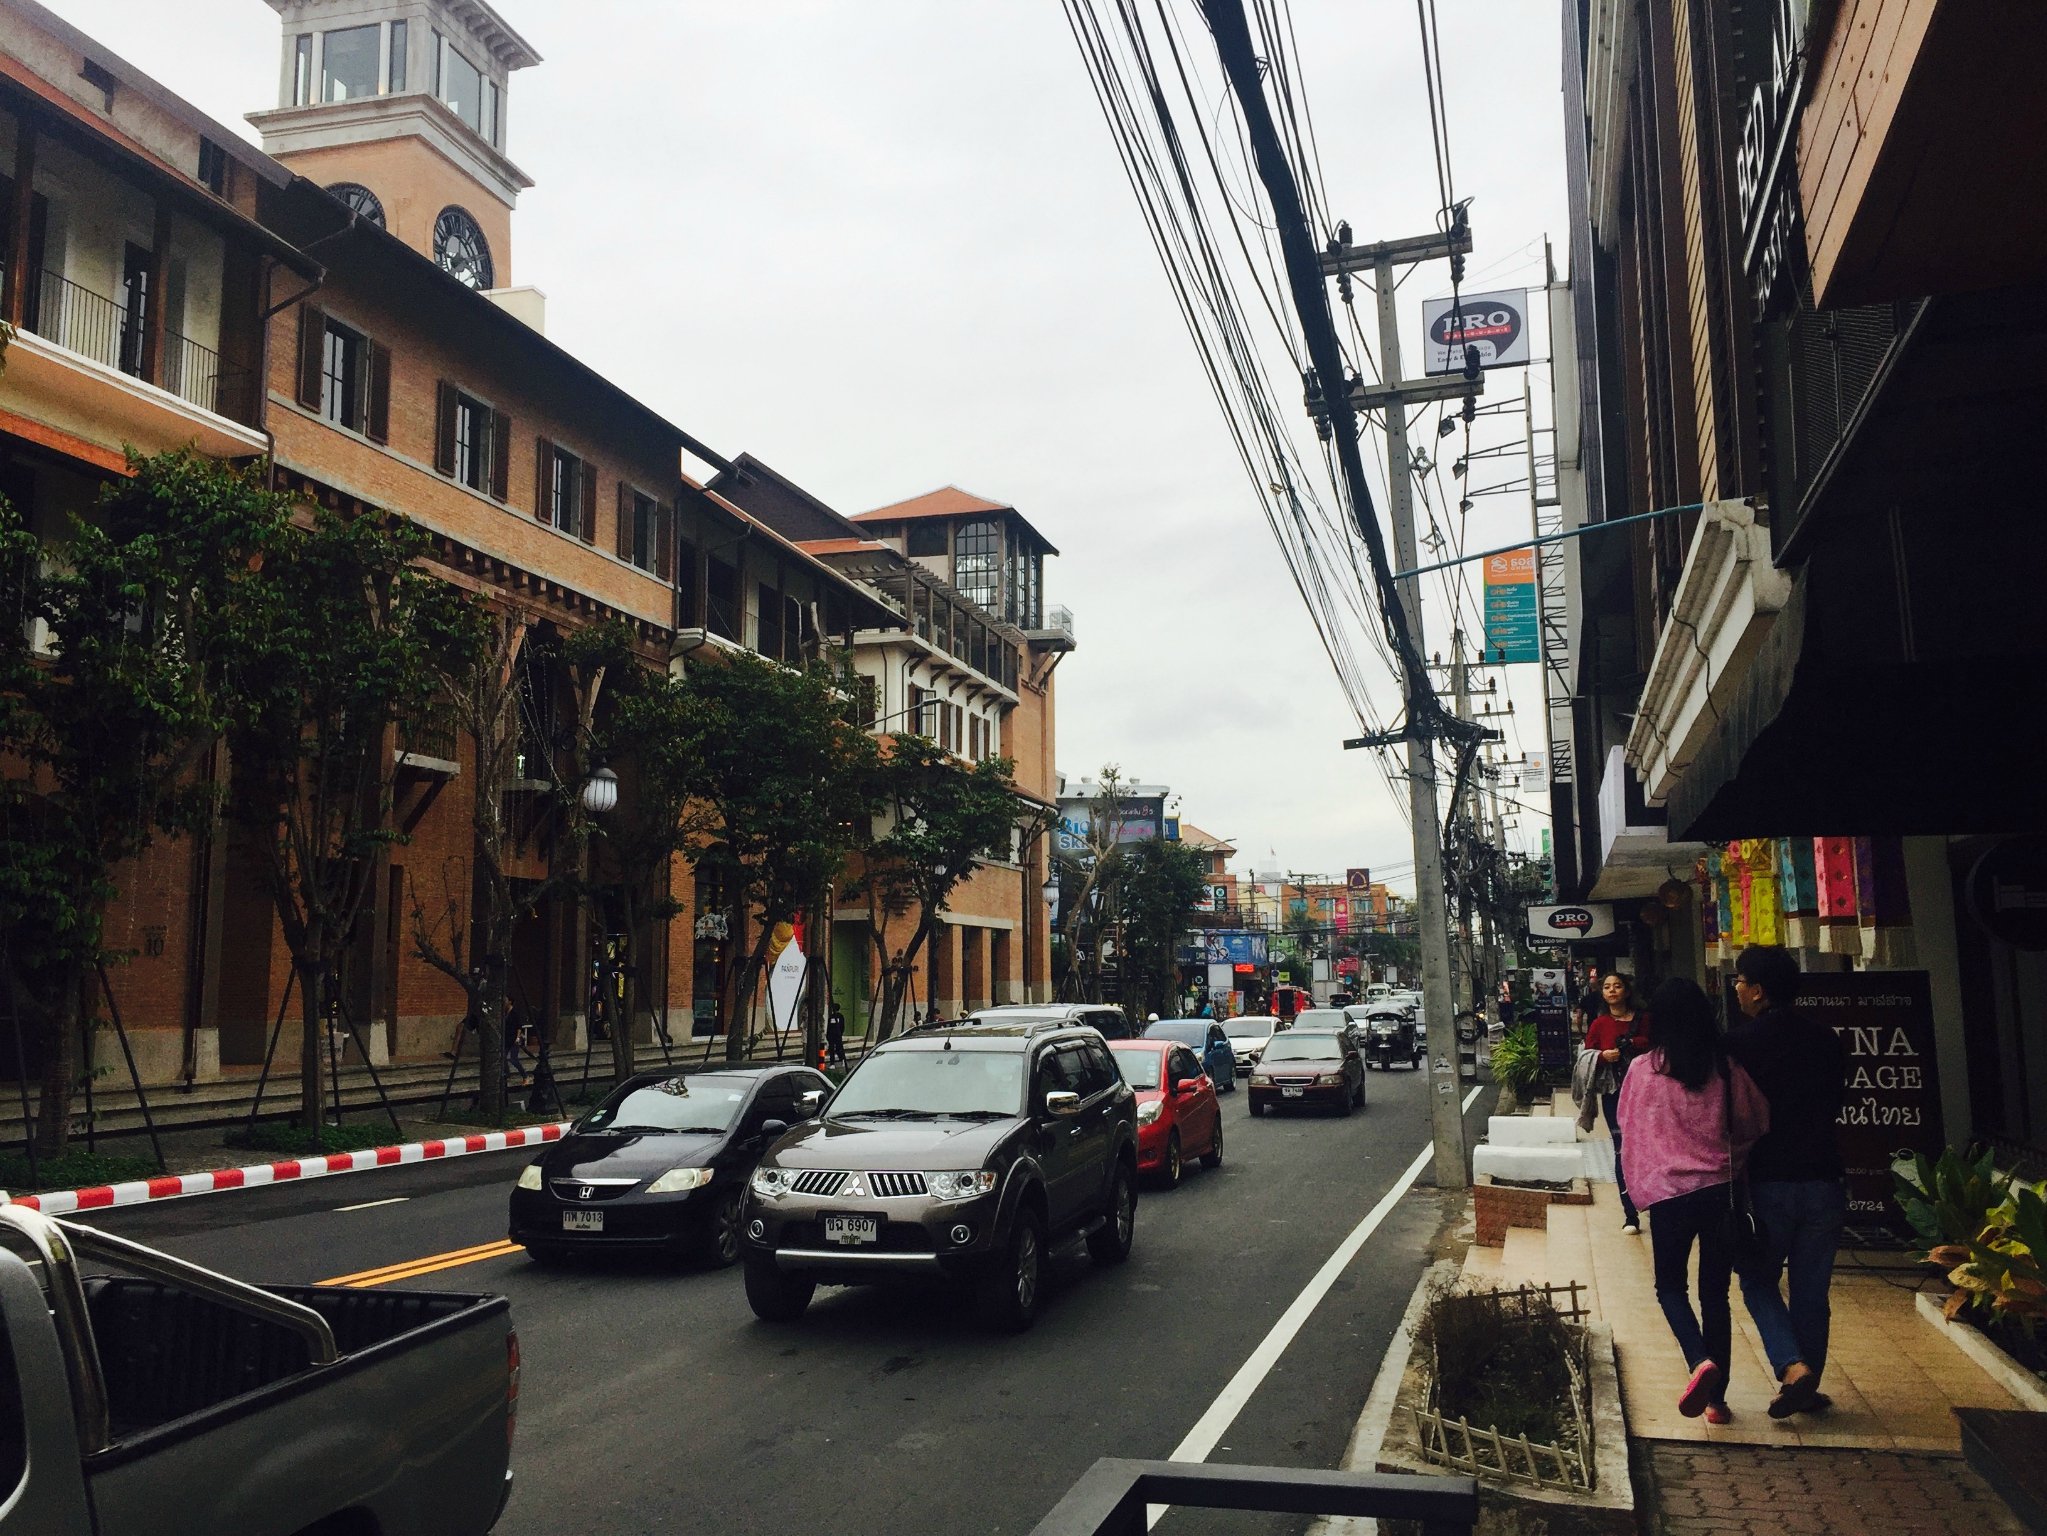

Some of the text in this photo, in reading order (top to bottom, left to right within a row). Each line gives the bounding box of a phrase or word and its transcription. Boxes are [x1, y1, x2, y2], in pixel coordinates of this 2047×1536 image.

[1737, 83, 1765, 237] BED
[1443, 310, 1511, 333] PRO
[1555, 913, 1589, 923] PRO
[1844, 1065, 1922, 1090] AGE
[580, 1211, 603, 1223] 7013
[848, 1219, 876, 1232] 6907
